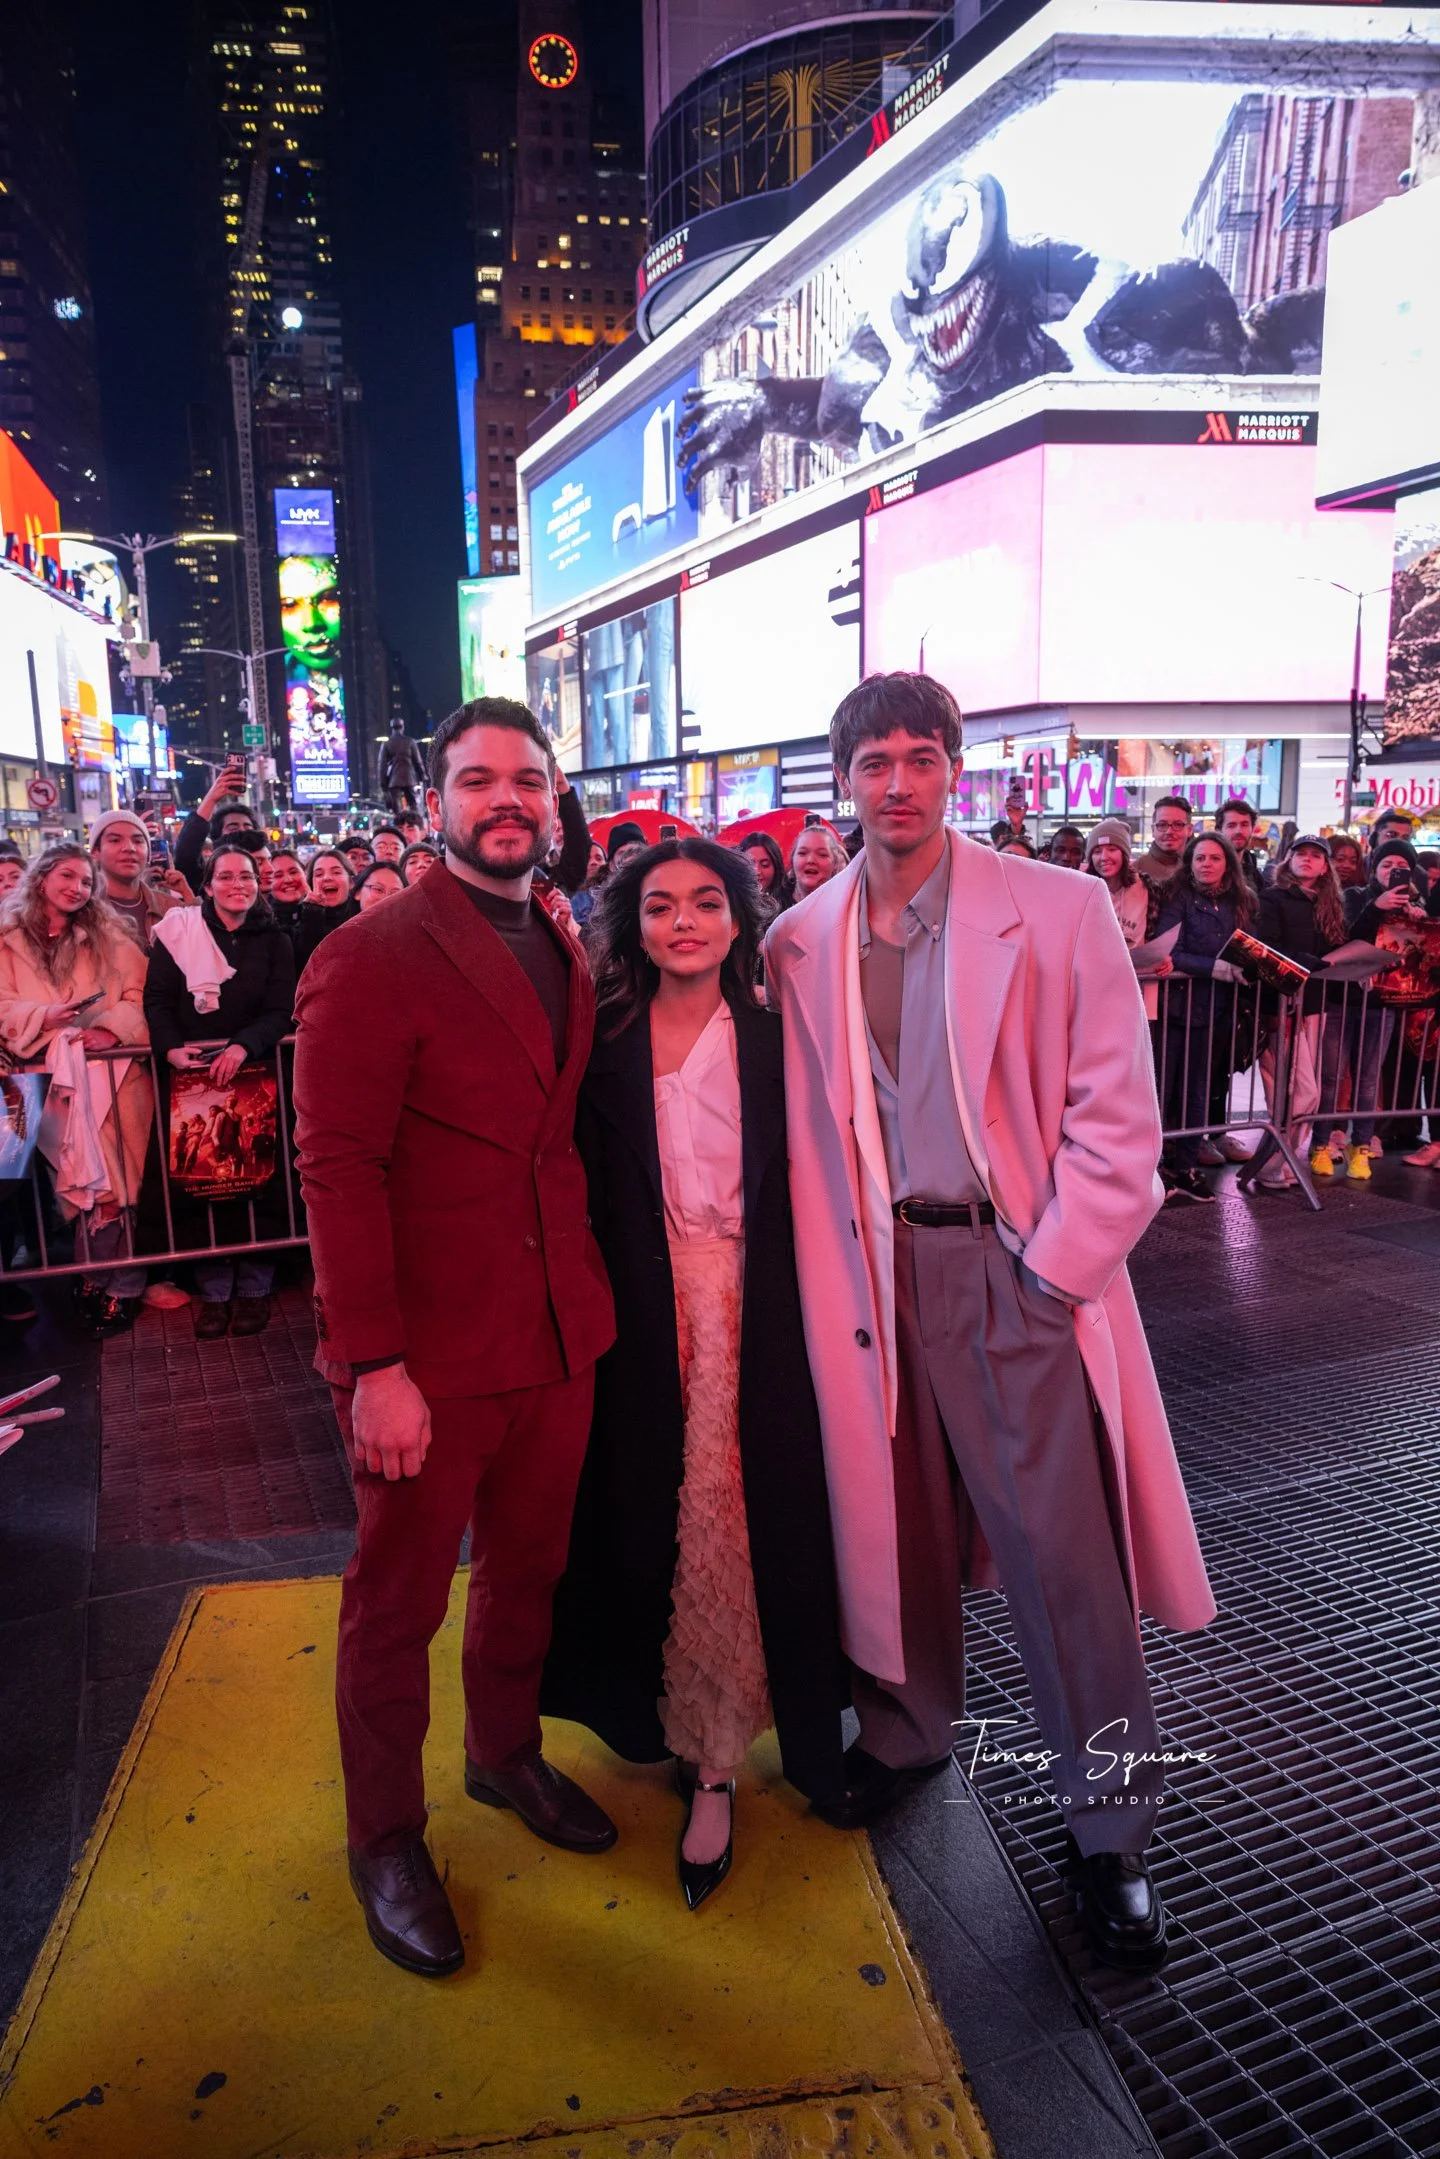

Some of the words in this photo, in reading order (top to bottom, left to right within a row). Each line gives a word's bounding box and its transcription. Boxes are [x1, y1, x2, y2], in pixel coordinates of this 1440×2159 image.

[894, 53, 950, 112] MARRIOTT
[894, 80, 942, 132] MARQUIS
[646, 227, 690, 270] MARRIOTT
[1237, 428, 1301, 441] MARQUIS
[1238, 414, 1310, 427] MARRIOTT
